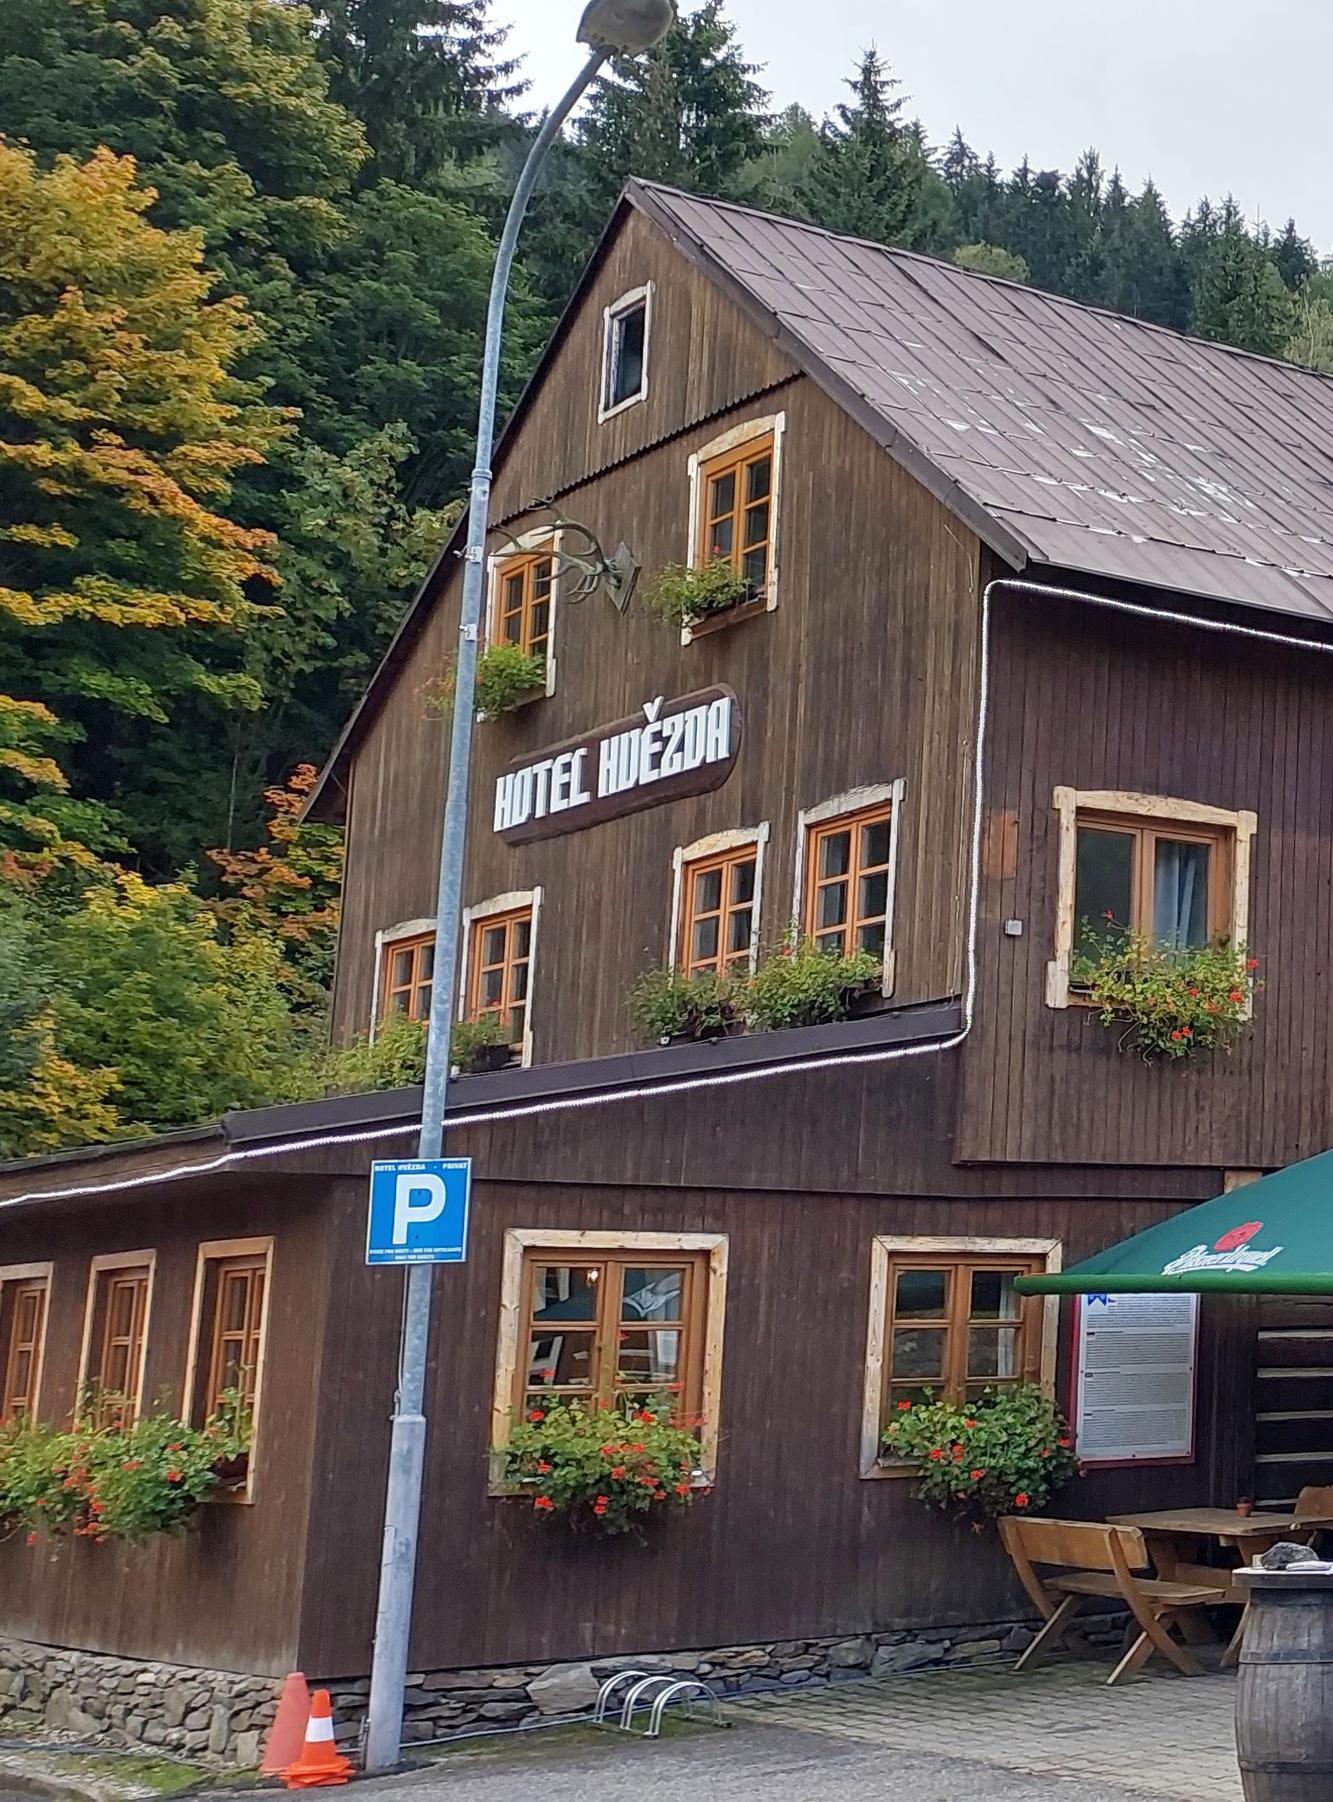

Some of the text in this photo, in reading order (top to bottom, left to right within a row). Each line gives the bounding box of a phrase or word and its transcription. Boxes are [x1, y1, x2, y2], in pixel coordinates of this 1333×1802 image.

[493, 695, 732, 833] HOTEL HVĚZDA
[392, 1173, 446, 1245] P
